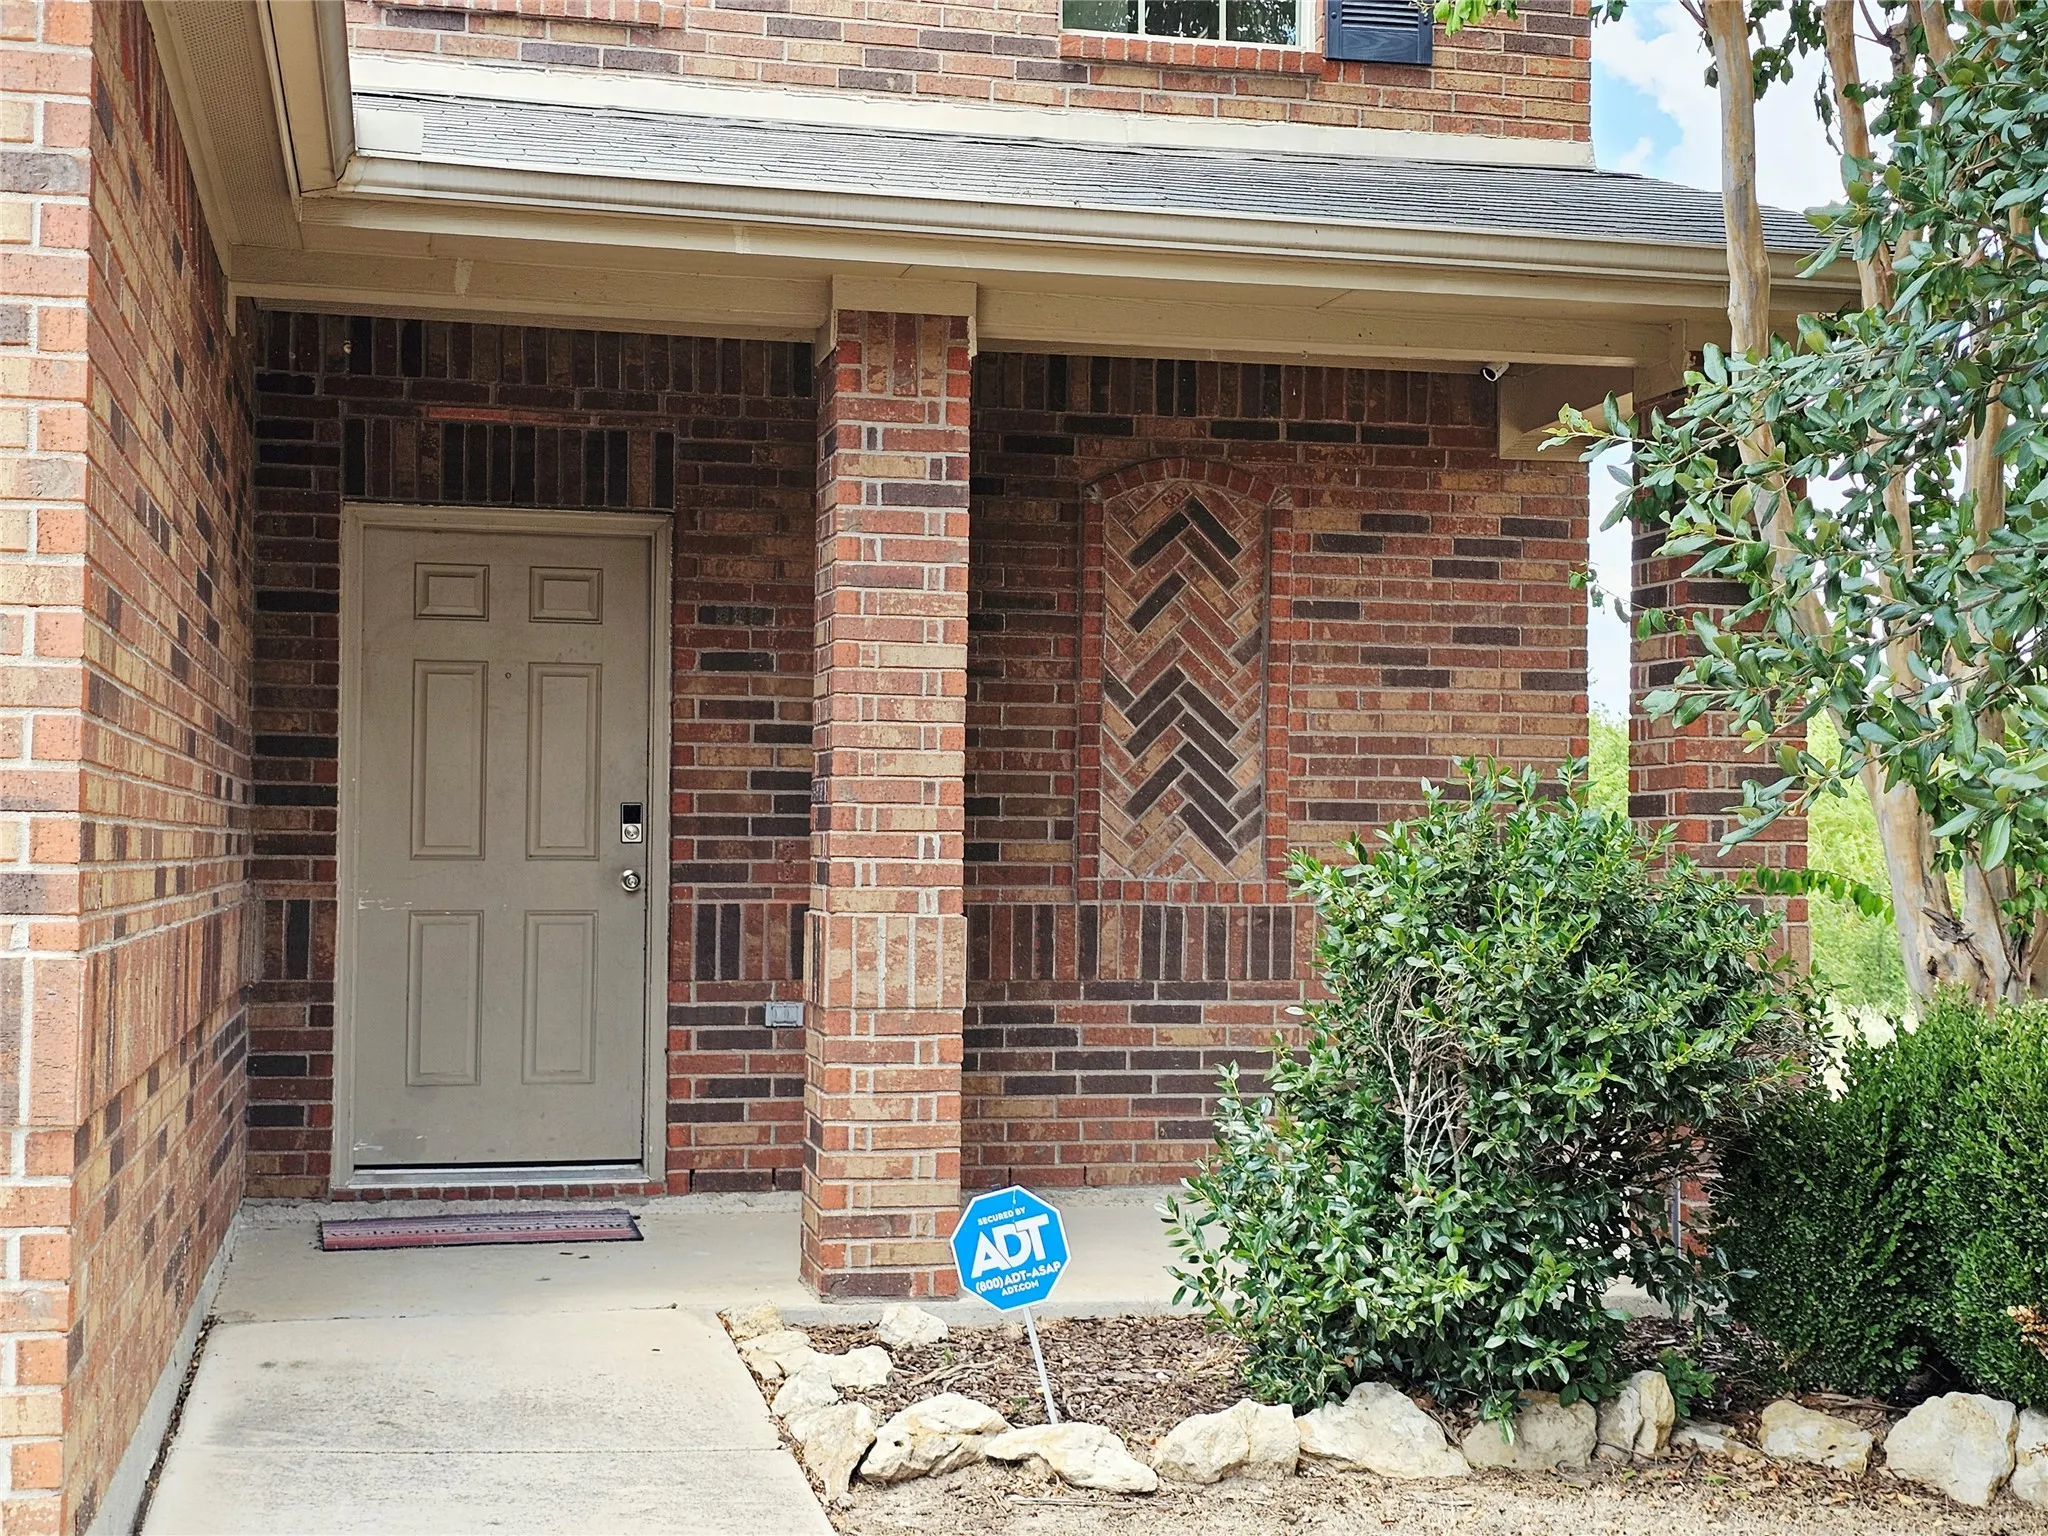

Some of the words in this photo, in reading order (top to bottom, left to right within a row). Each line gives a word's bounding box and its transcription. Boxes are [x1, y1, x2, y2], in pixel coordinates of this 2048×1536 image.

[977, 1209, 1014, 1226] SECURED
[1015, 1206, 1026, 1217] BY
[970, 1213, 1050, 1279] ADT
[975, 1275, 1004, 1295] (800)
[1004, 1260, 1062, 1286] ADT-ASAP
[1001, 1279, 1040, 1297] ADT.COM
